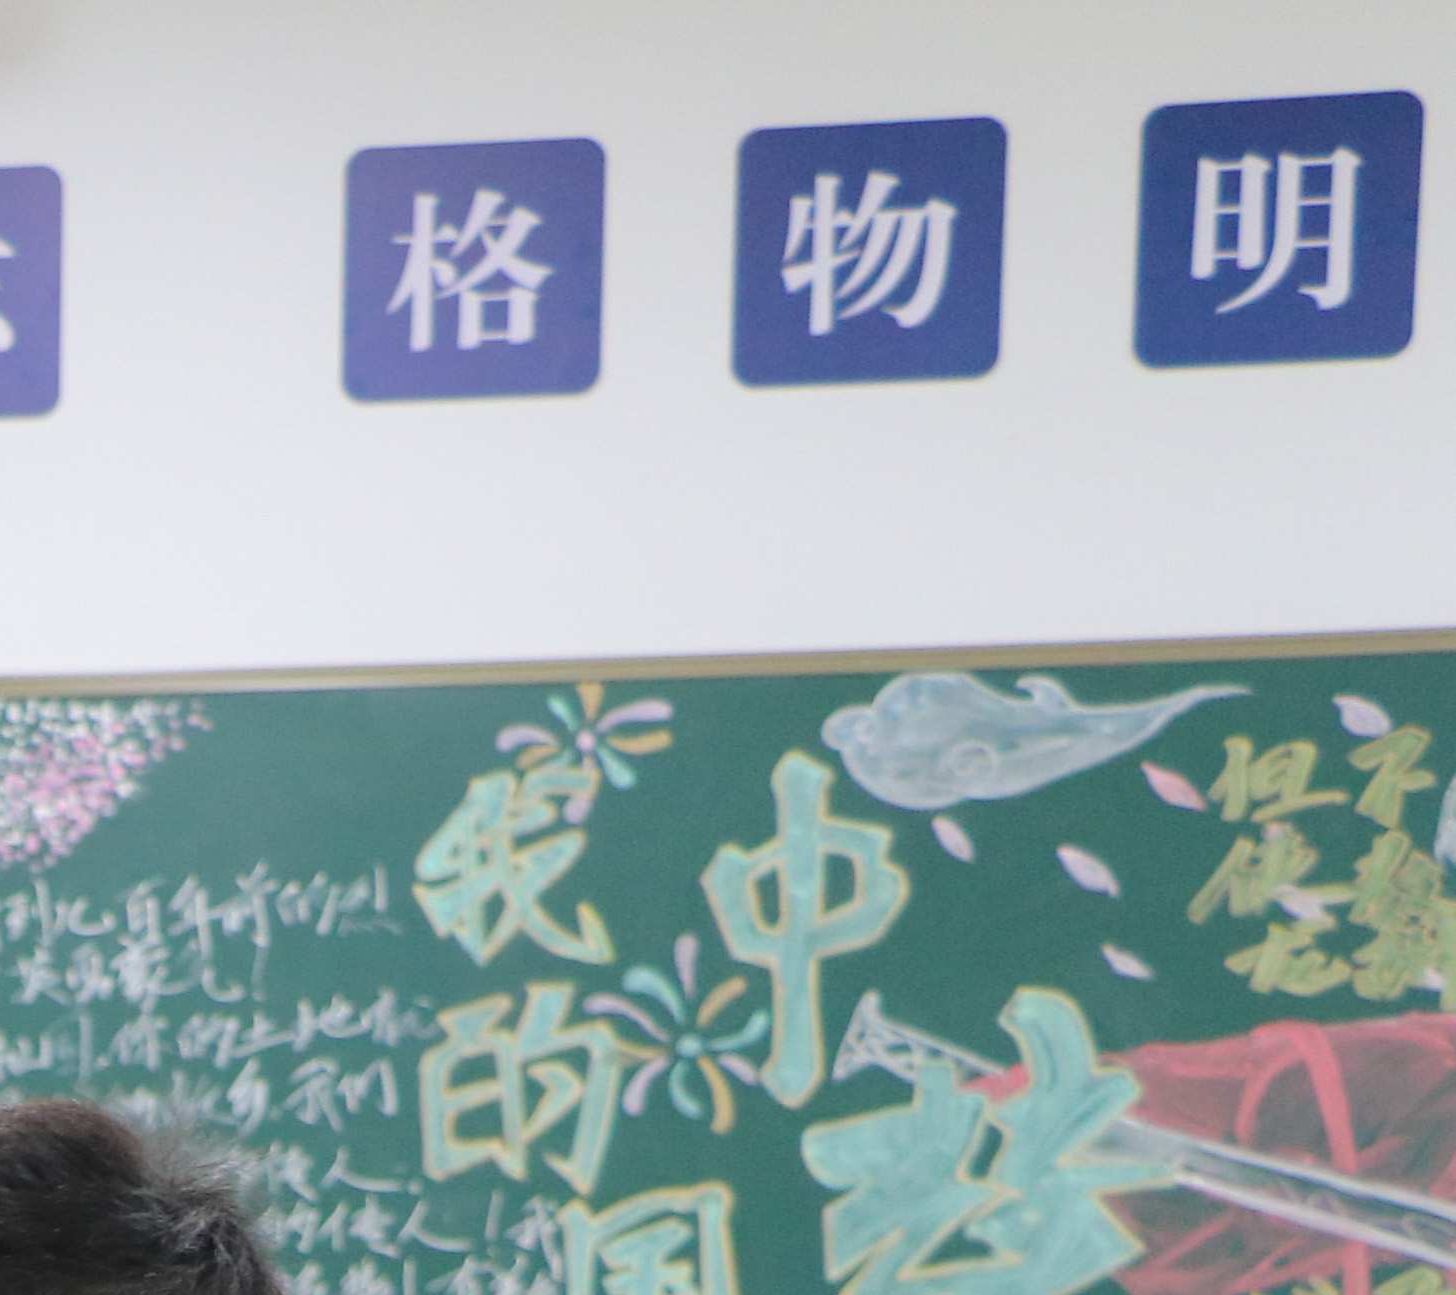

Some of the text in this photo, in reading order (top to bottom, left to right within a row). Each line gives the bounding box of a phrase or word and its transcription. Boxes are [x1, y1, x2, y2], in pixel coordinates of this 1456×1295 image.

[413, 768, 615, 966] 我
[700, 748, 911, 1107] 中
[418, 980, 620, 1195] 的
